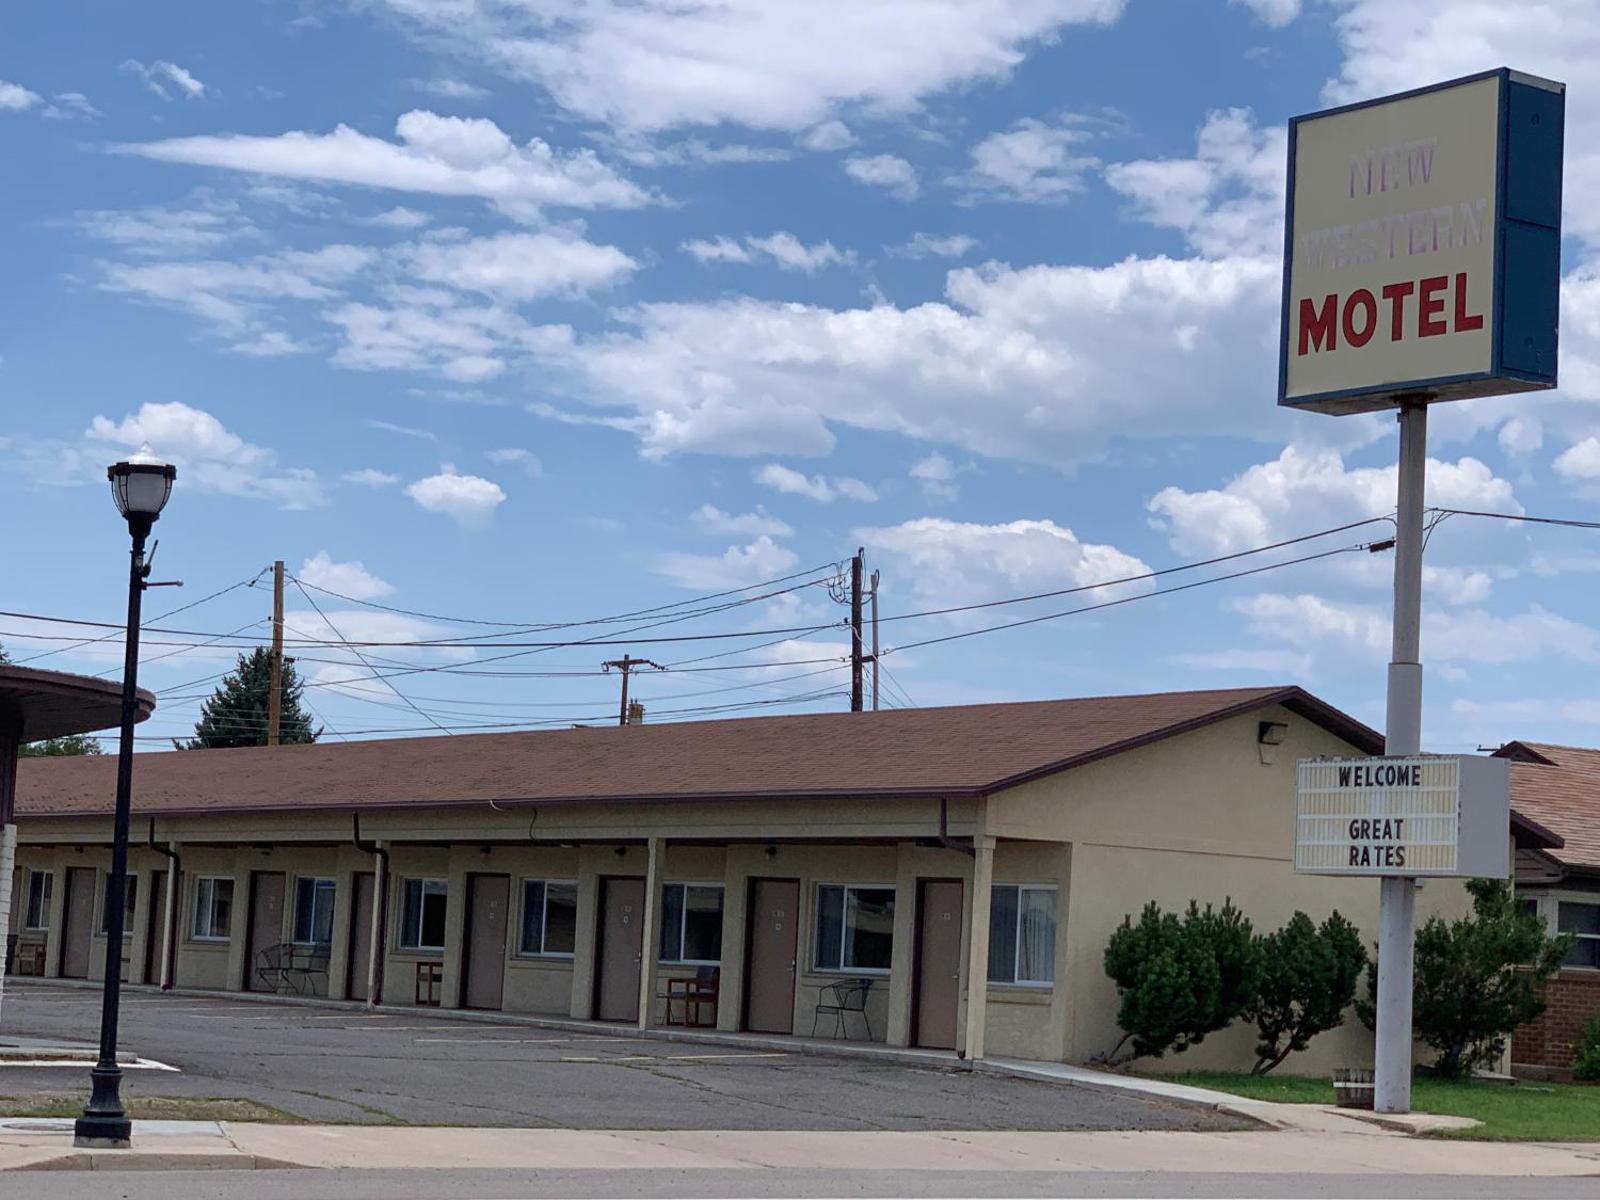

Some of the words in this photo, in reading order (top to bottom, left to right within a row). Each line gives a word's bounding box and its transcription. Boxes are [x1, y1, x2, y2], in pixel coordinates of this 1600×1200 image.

[1348, 136, 1437, 199] NEW
[1298, 272, 1484, 356] MOTEL
[1339, 765, 1421, 787] WELCOME
[1349, 818, 1404, 840] GREAT
[1349, 845, 1406, 867] RATES
